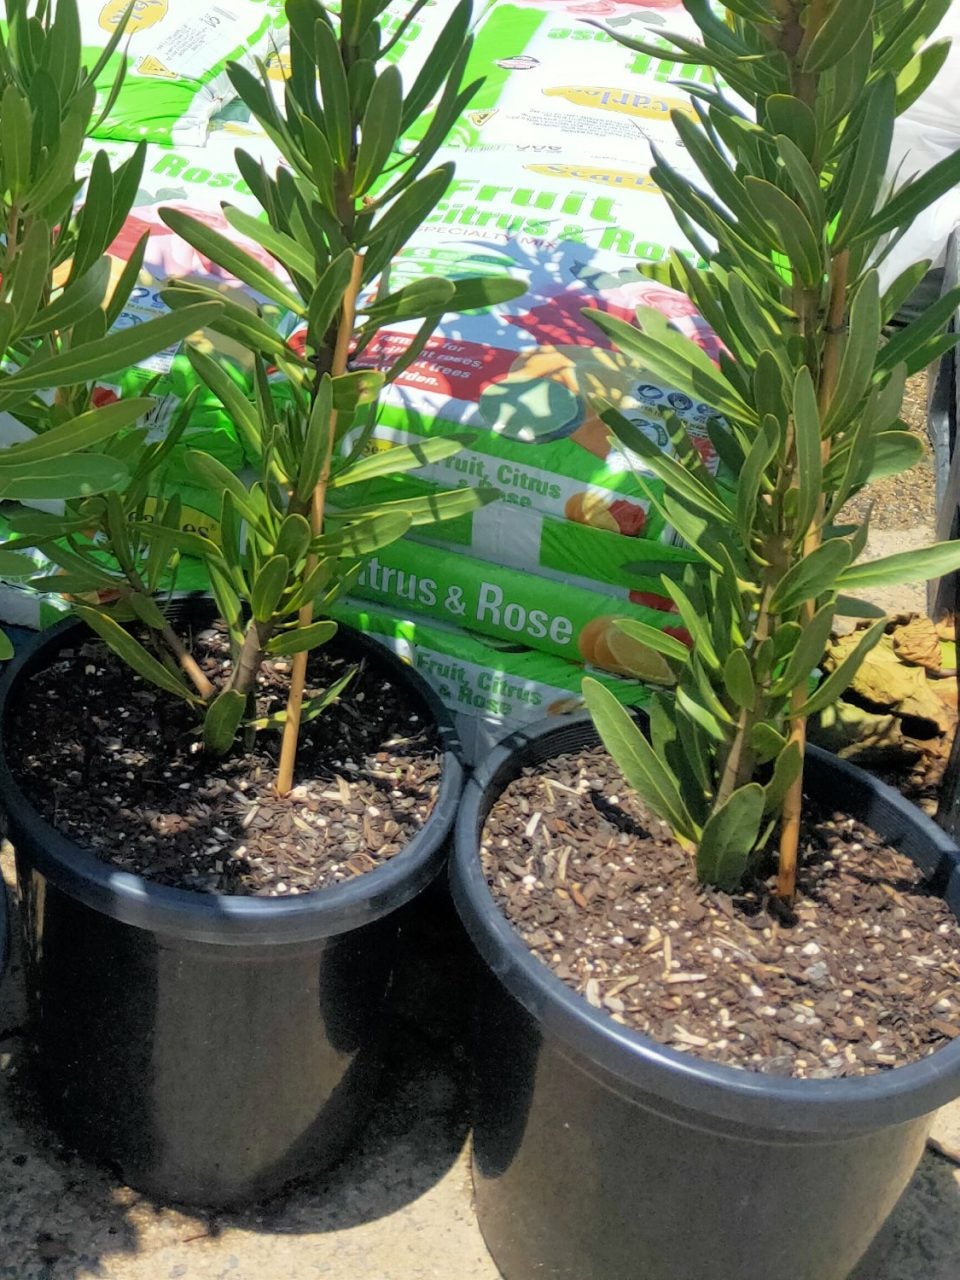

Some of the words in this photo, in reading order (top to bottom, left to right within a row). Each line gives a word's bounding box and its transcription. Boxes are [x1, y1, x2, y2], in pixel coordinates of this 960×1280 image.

[439, 178, 622, 223] Fruit
[520, 236, 557, 249] MIX
[442, 342, 465, 353] for
[496, 464, 563, 501] Citrus
[444, 585, 467, 617] &
[476, 581, 573, 645] Rose
[457, 686, 513, 716] Rose
[477, 674, 542, 706] Citrus
